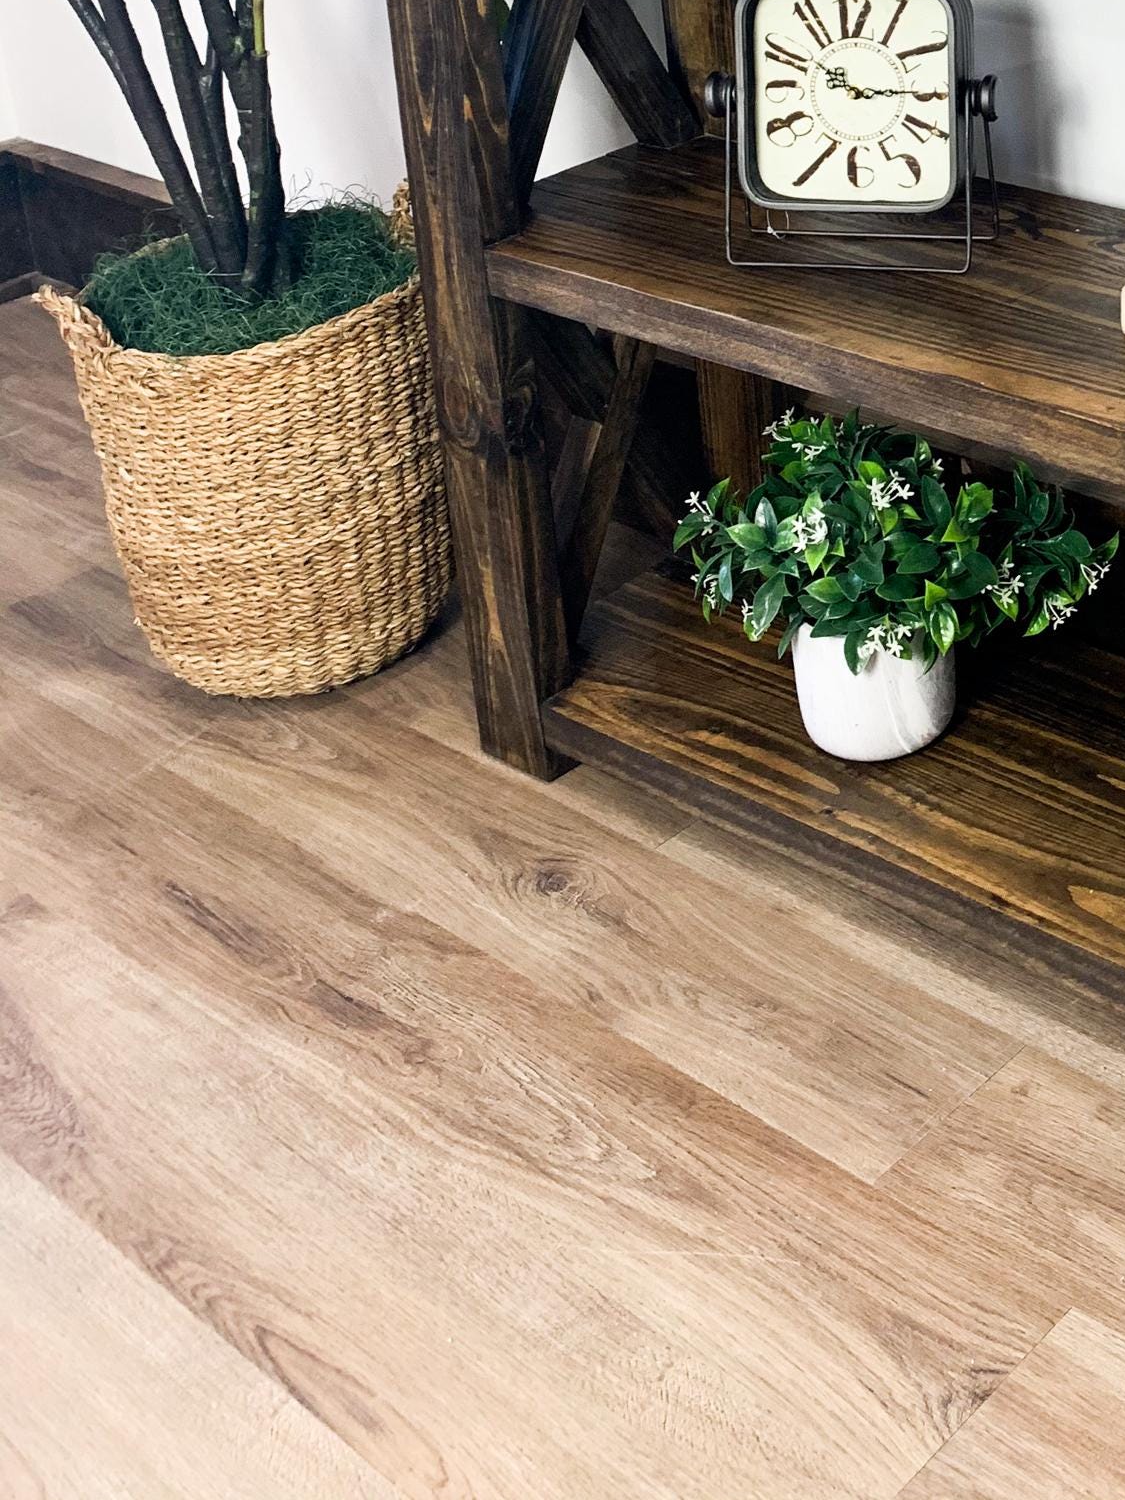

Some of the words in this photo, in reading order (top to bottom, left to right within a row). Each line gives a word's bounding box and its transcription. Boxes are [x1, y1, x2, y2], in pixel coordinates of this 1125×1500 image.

[764, 32, 814, 76] 10
[895, 30, 949, 73] 2
[764, 79, 805, 104] 9
[911, 79, 949, 102] 3
[766, 111, 815, 148] 8
[901, 114, 950, 143] 4
[792, 132, 842, 187] 7
[847, 145, 875, 188] 6
[878, 134, 921, 188] 5
